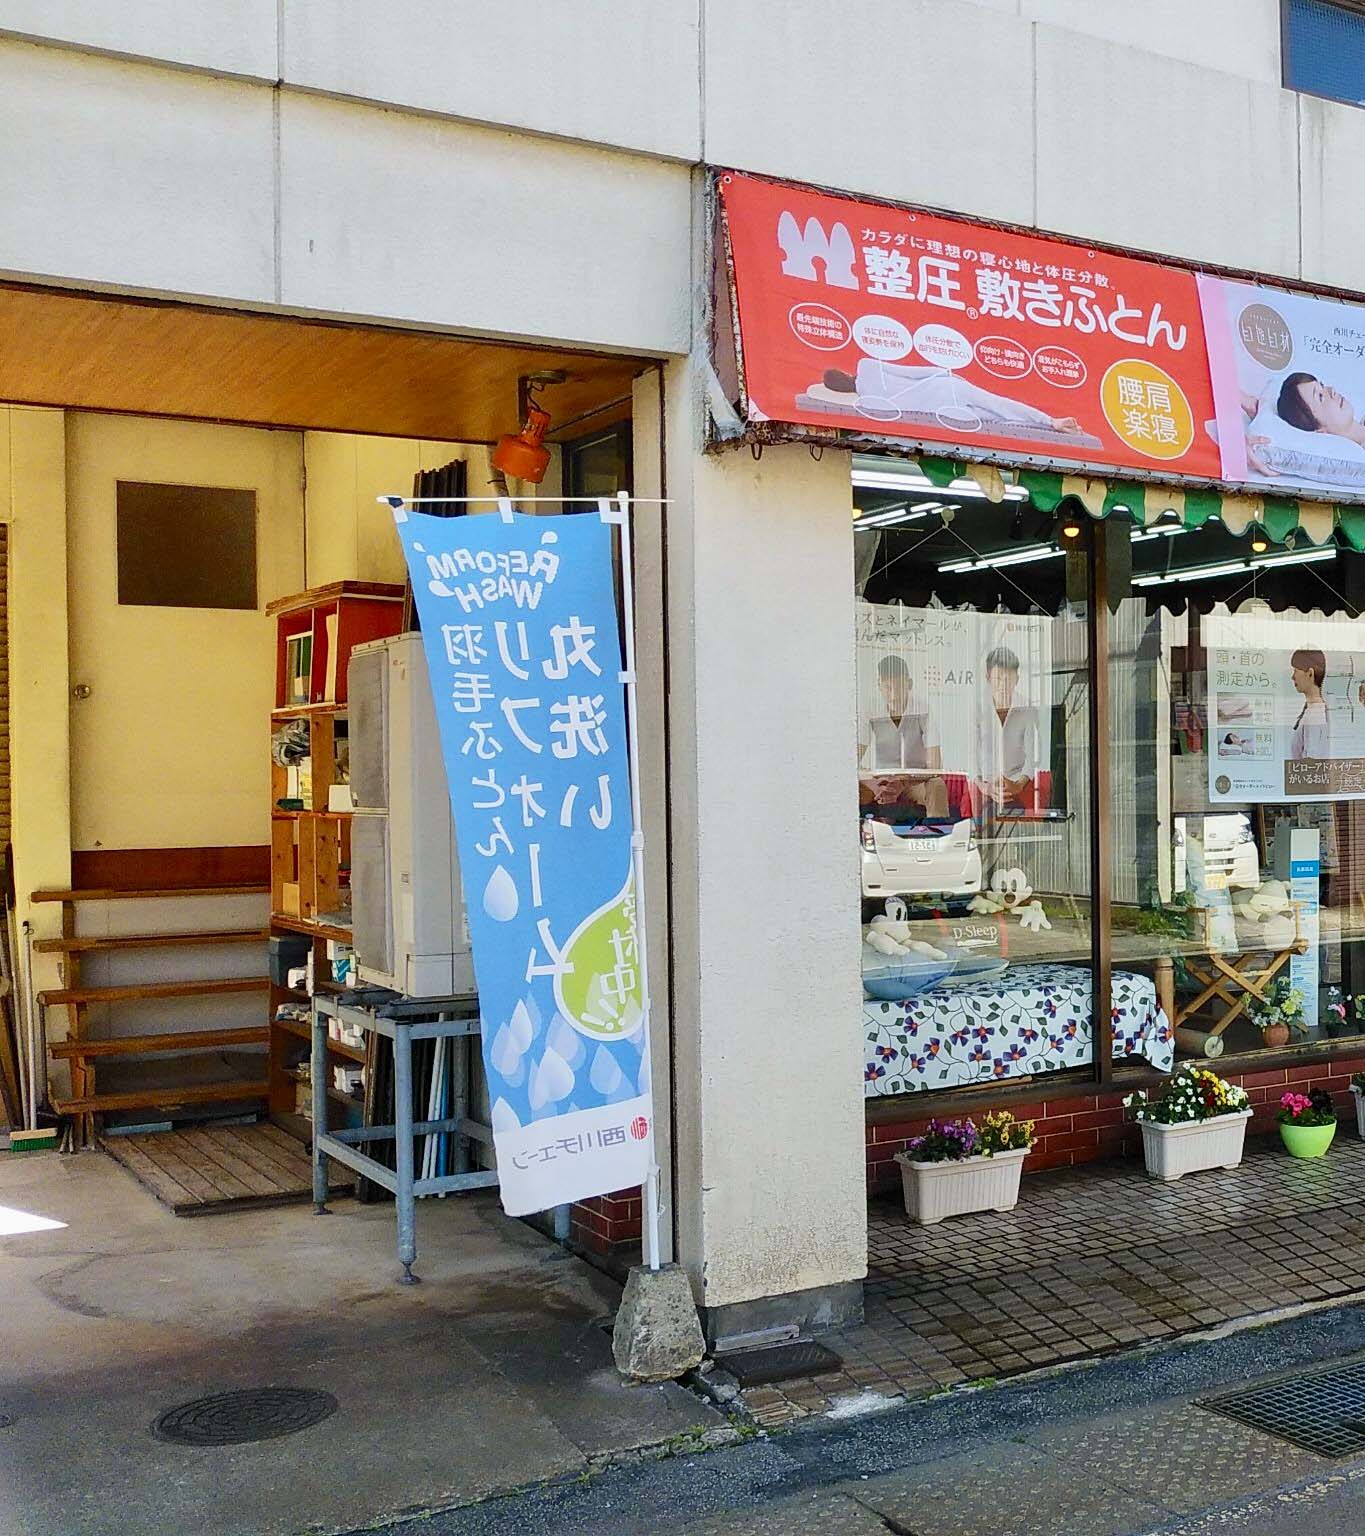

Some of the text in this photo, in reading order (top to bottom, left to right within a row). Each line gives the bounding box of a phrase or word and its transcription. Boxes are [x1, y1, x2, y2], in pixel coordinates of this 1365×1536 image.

[975, 266, 1187, 351] 敷きふとん
